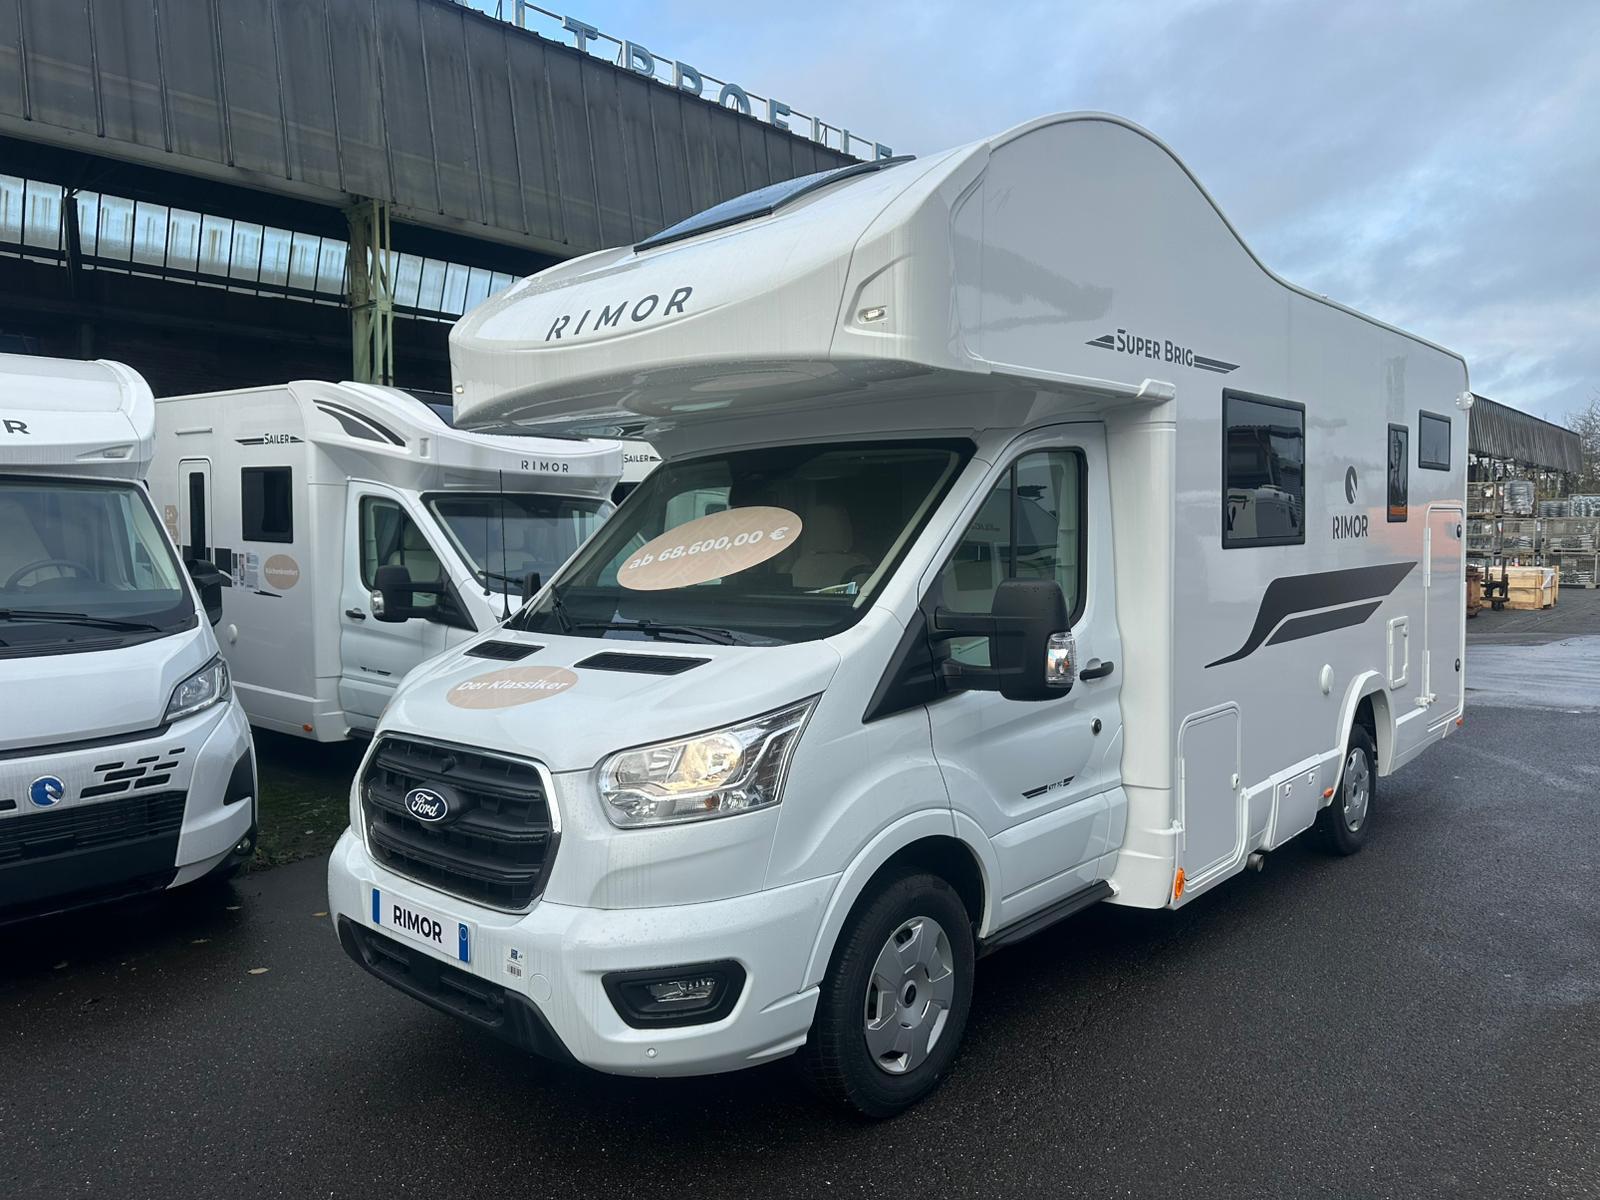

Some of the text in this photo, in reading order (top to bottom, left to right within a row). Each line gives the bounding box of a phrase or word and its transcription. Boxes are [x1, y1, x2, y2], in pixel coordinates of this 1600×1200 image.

[545, 286, 693, 342] RIMOR
[1116, 328, 1193, 367] SUPER BRIG
[264, 433, 290, 444] SAILER
[521, 460, 569, 473] RIMOR
[623, 453, 649, 463] SAILER
[1332, 514, 1369, 540] RIMOR
[628, 526, 790, 570] ab 68.600,00 €
[456, 679, 569, 691] Der Klassiker
[410, 791, 440, 817] Ford
[393, 904, 443, 944] RIMOR
